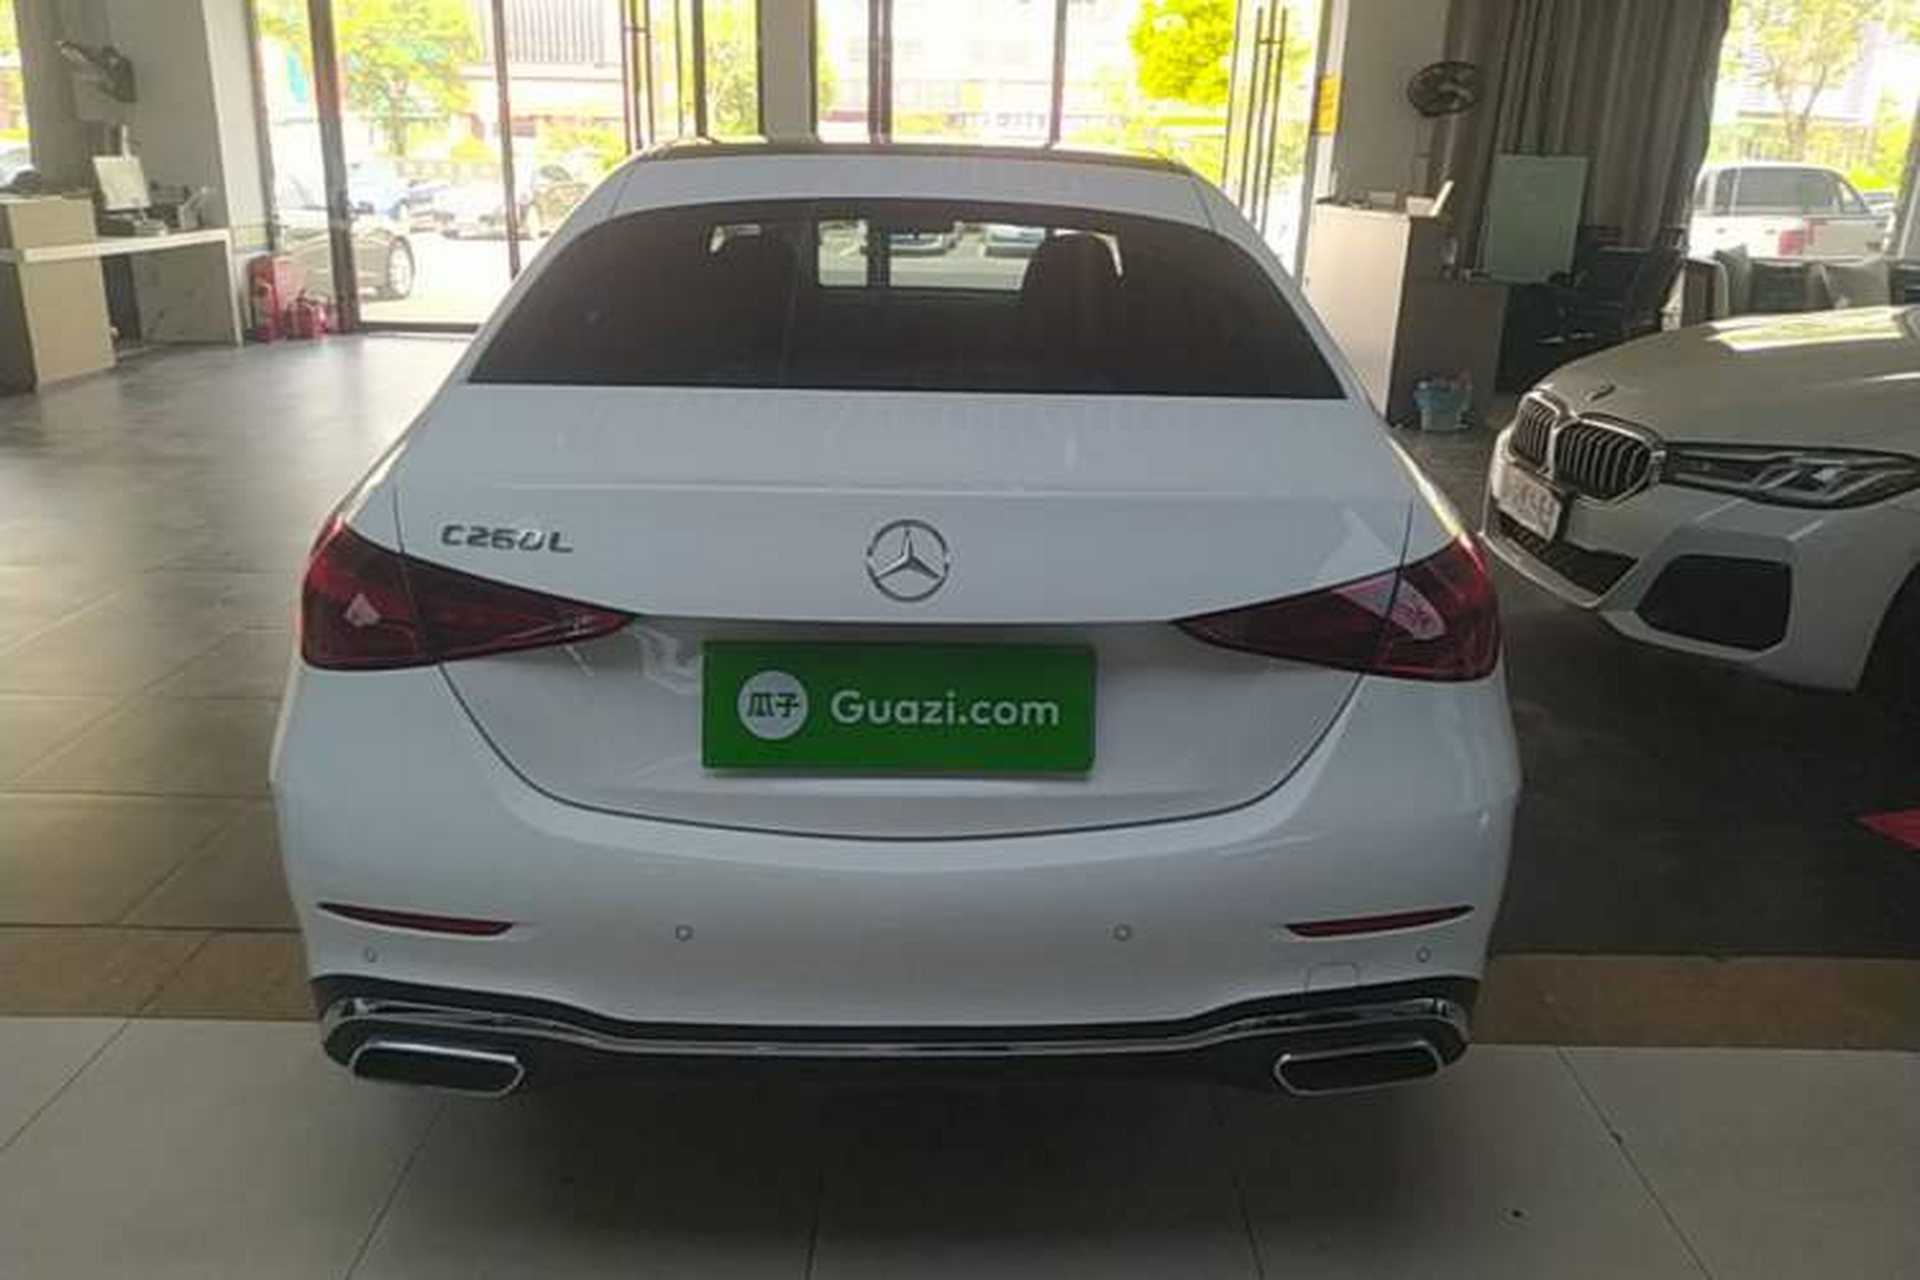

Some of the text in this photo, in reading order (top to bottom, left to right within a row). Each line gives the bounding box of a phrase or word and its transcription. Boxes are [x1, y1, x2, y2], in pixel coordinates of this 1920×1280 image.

[441, 524, 574, 553] C260L
[747, 692, 800, 718] 瓜子
[830, 690, 1060, 726] Guazi.com
